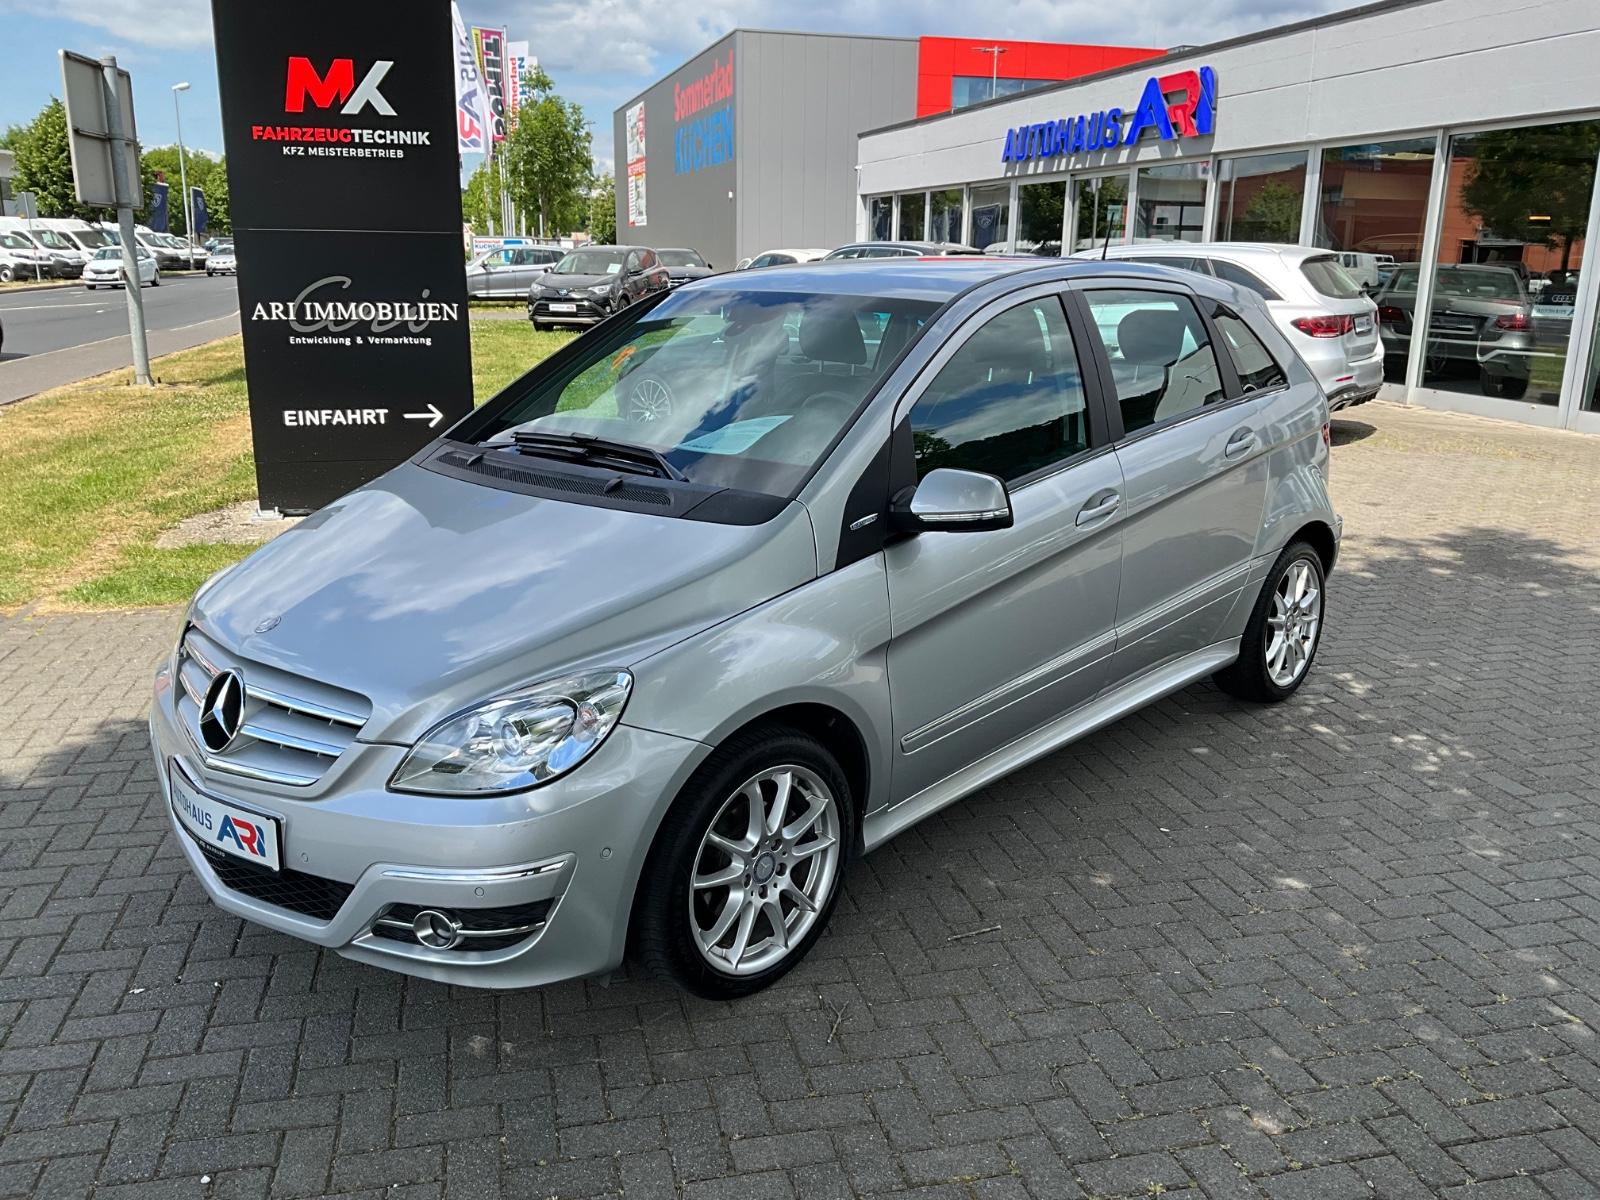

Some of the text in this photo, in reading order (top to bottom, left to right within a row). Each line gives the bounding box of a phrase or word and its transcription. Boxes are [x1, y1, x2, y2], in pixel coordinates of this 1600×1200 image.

[285, 56, 398, 116] MK
[674, 49, 734, 122] Sommerlad
[1002, 66, 1216, 162] AUTOHAUS ARI
[251, 125, 431, 145] FAHRZEUGTECHNIK
[283, 146, 404, 158] KFZ MEISTERBETRIEB
[252, 302, 459, 321] ARI IMMOBILIEN
[289, 336, 432, 346] Entwicklung & Vermarktung
[283, 408, 389, 426] EINFAHRT
[173, 780, 266, 858] AUTOHAUS ARI
